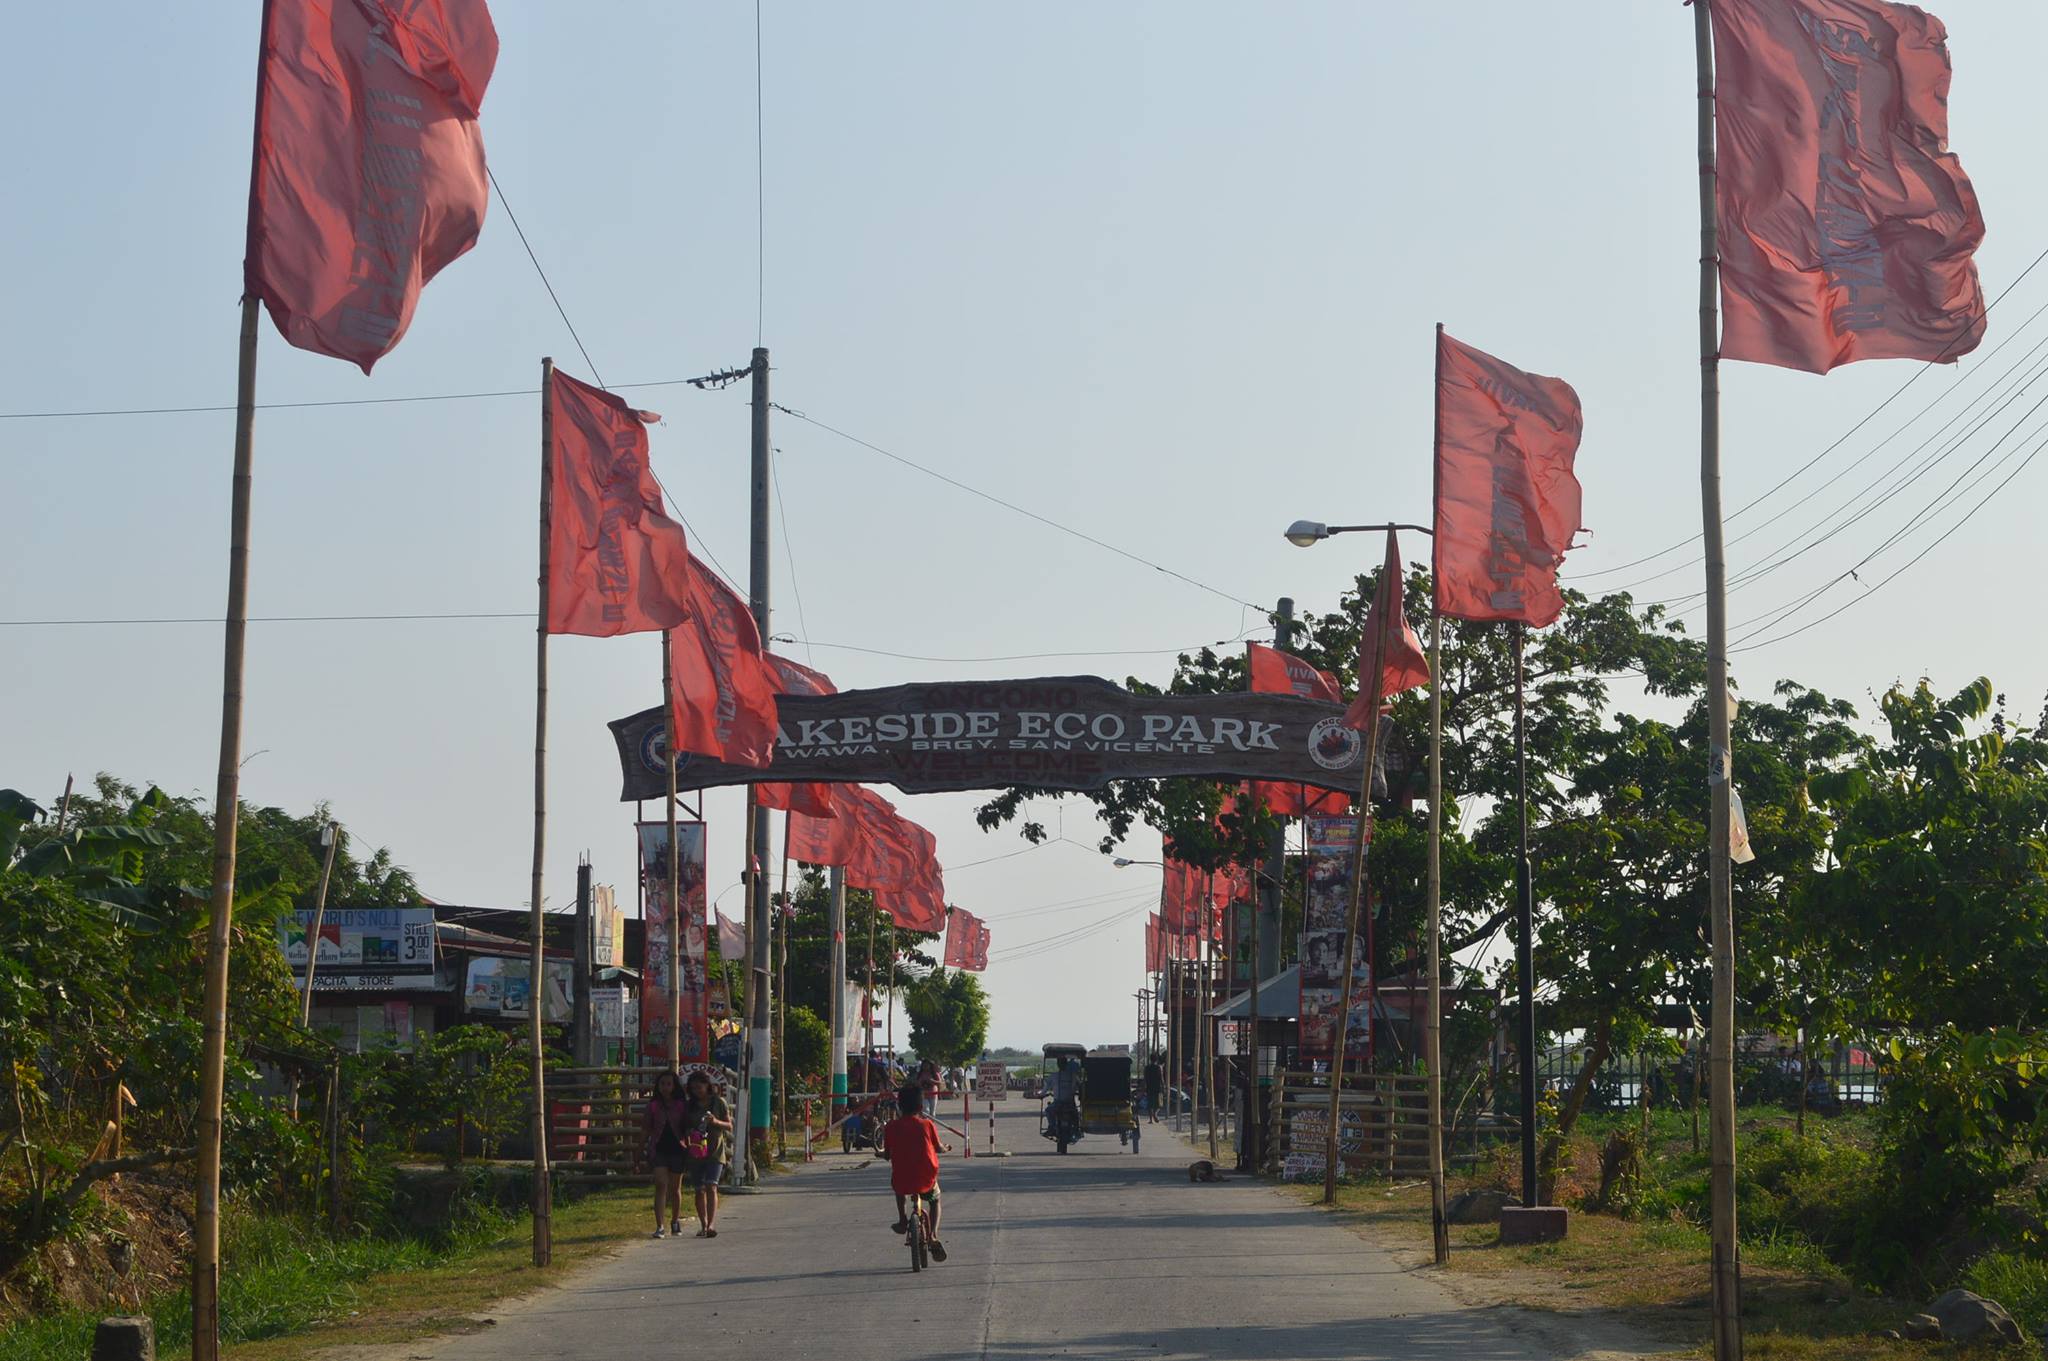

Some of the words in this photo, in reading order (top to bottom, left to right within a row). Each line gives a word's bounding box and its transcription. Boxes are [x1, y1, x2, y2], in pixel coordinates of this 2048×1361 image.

[1285, 667, 1316, 681] VIVA
[775, 711, 1001, 748] AKESIDE
[1016, 711, 1125, 741] ECO
[1142, 714, 1283, 751] PARK
[912, 739, 998, 751] BRGY.
[1008, 738, 1072, 751] SAN
[1084, 740, 1216, 754] VICENTE
[892, 750, 1102, 774] WELCOME
[404, 923, 429, 936] STILL
[358, 976, 394, 986] STORE
